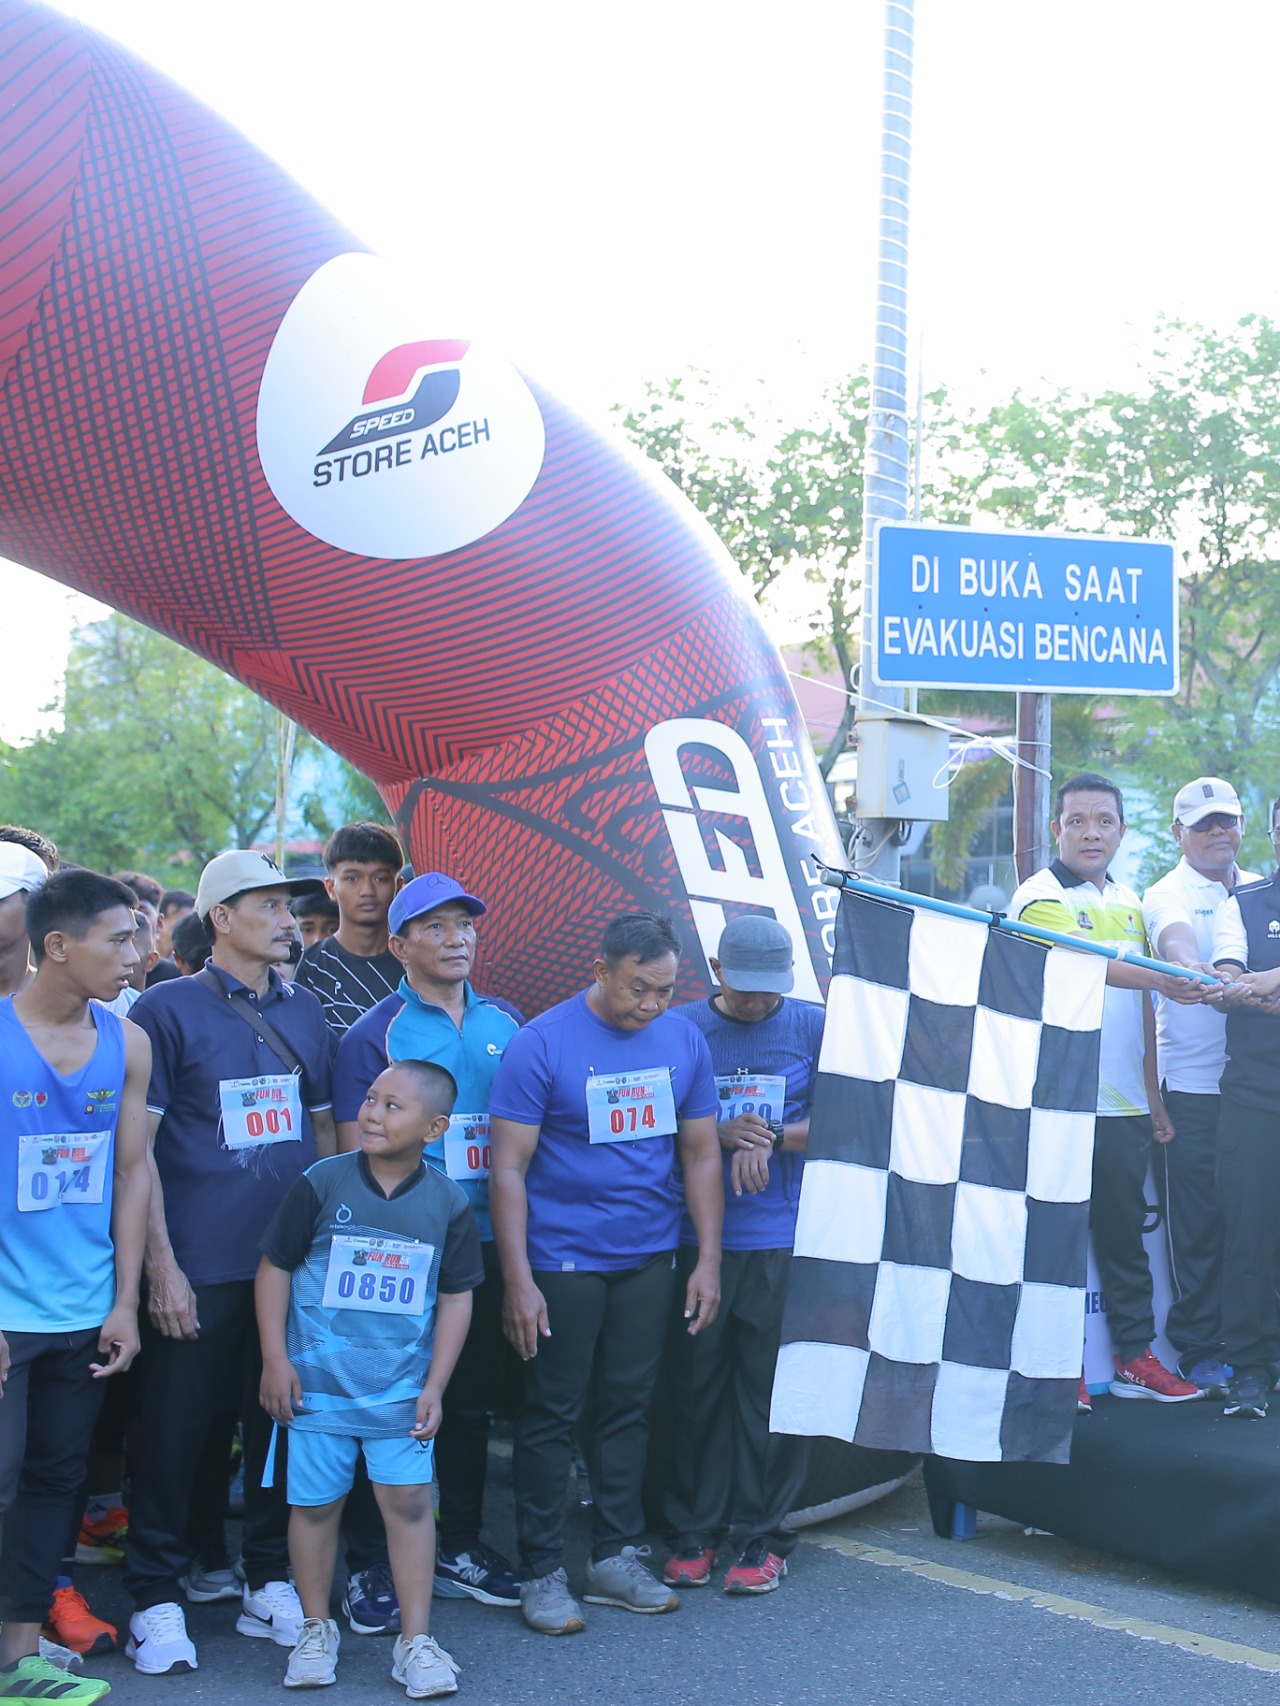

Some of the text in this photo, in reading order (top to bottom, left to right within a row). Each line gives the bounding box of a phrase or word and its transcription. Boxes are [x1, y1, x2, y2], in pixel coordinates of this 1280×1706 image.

[350, 407, 416, 440] SPEED
[312, 417, 491, 487] STORE ACEH
[911, 554, 1143, 605] DI BUKA SAAT
[883, 615, 1168, 666] EVAKUASI BENCANA
[760, 716, 824, 844] ACEH
[246, 1107, 292, 1137] 001
[610, 1104, 656, 1134] 074
[467, 1145, 490, 1170] 00
[366, 1251, 384, 1262] FUN
[385, 1253, 401, 1264] RUN
[338, 1270, 415, 1304] 0850
